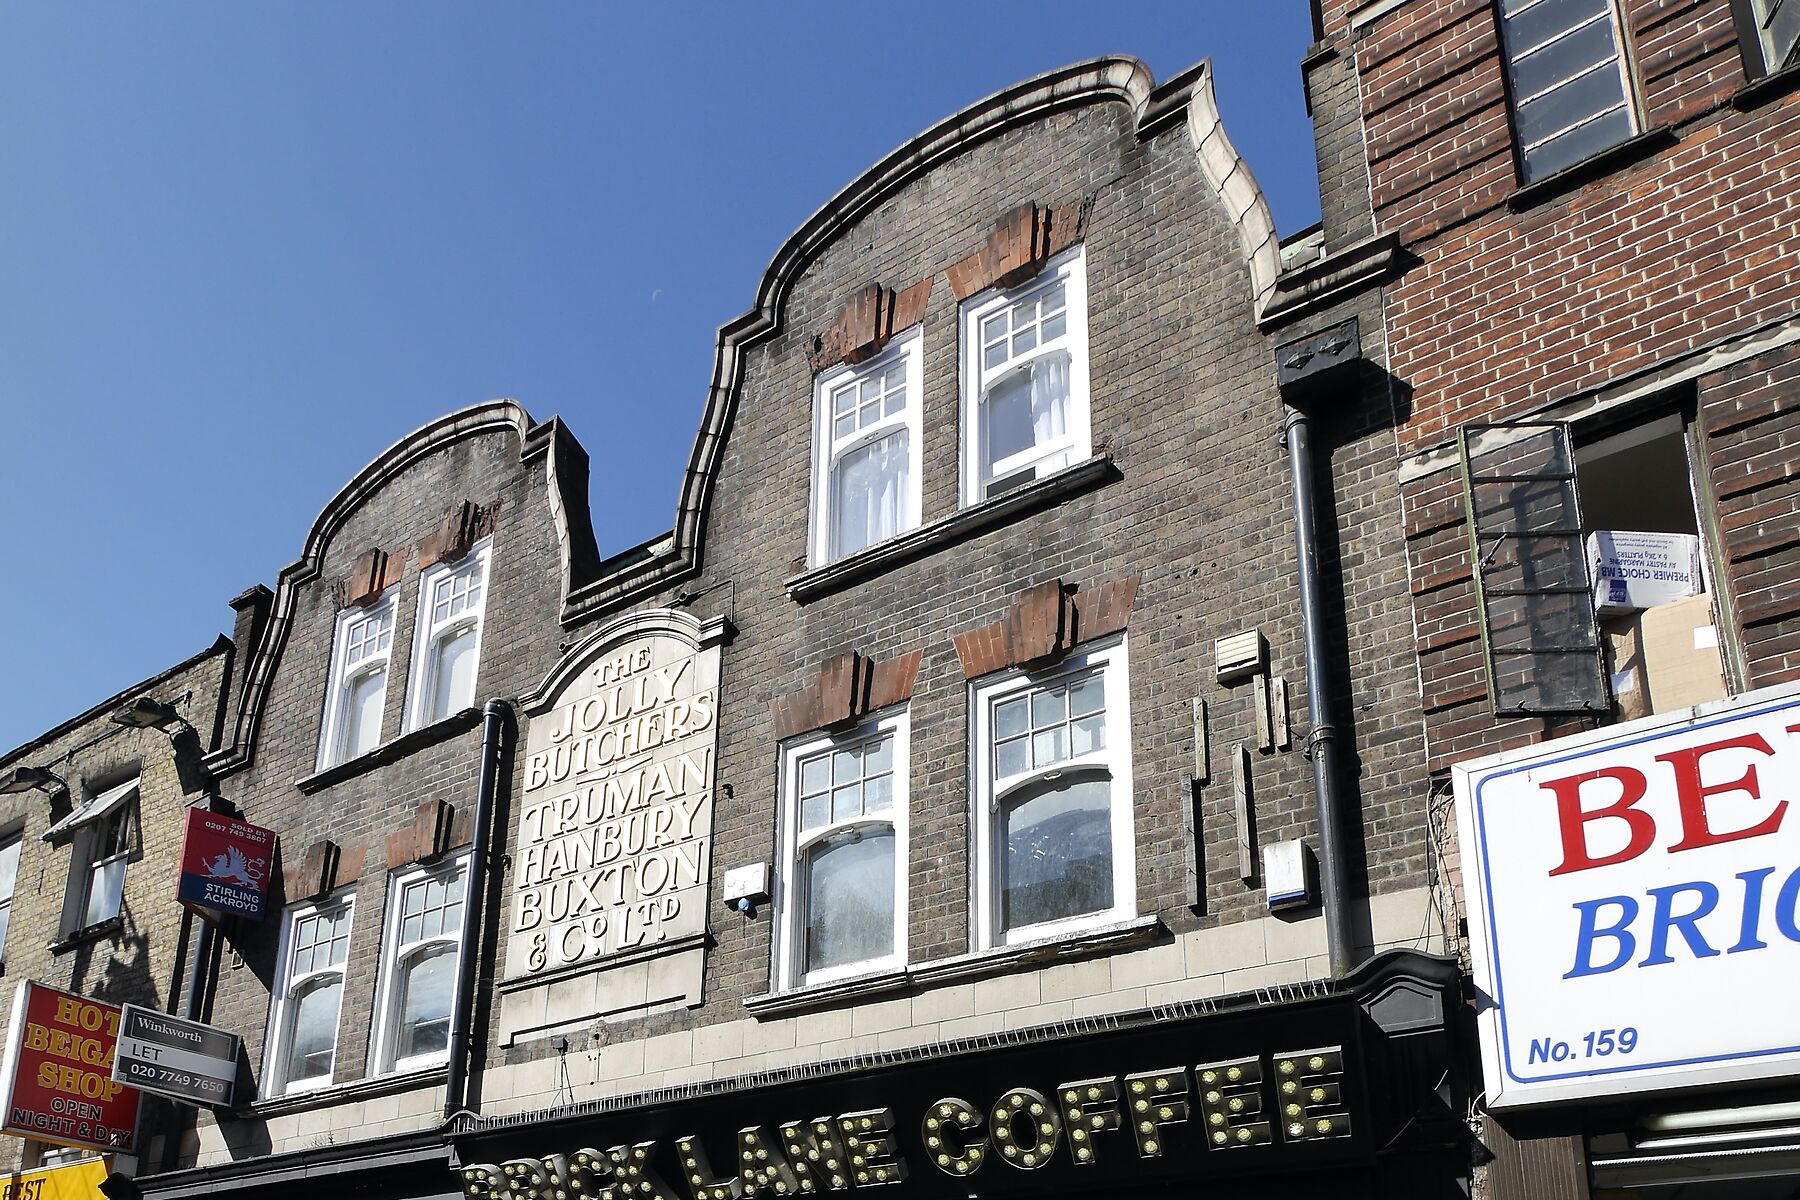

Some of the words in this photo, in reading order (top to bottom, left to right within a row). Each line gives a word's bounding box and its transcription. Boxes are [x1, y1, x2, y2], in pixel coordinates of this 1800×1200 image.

[1601, 566, 1616, 577] MB
[1619, 566, 1650, 579] CHOICE
[1653, 569, 1689, 582] PREMIER
[592, 647, 652, 687] THE
[549, 658, 692, 743] JOLLY
[524, 690, 714, 793] BUTCHERS
[525, 748, 711, 843] TRUMAN
[1539, 724, 1800, 876] BE
[205, 821, 227, 832] 0207
[229, 828, 244, 837] 749
[231, 822, 253, 833] SOLD
[255, 830, 267, 838] BY
[518, 793, 708, 889] HANBURY
[204, 892, 258, 912] ACKROYD
[206, 883, 259, 903] STIRLING
[514, 840, 704, 933] BUXTON
[524, 931, 547, 972] &
[54, 996, 120, 1038] HOT
[138, 1017, 202, 1042] Winkworth
[25, 1022, 117, 1069] BEIGA
[132, 1043, 163, 1060] LET
[37, 1061, 123, 1102] SHOP
[131, 1064, 156, 1078] 020
[159, 1070, 191, 1086] 7749
[194, 1078, 224, 1093] 7650
[12, 1107, 75, 1134] NIGHT
[78, 1122, 91, 1137] &
[95, 1125, 131, 1145] DAY
[51, 1097, 103, 1121] OPEN
[921, 1045, 1352, 1177] COFFEE
